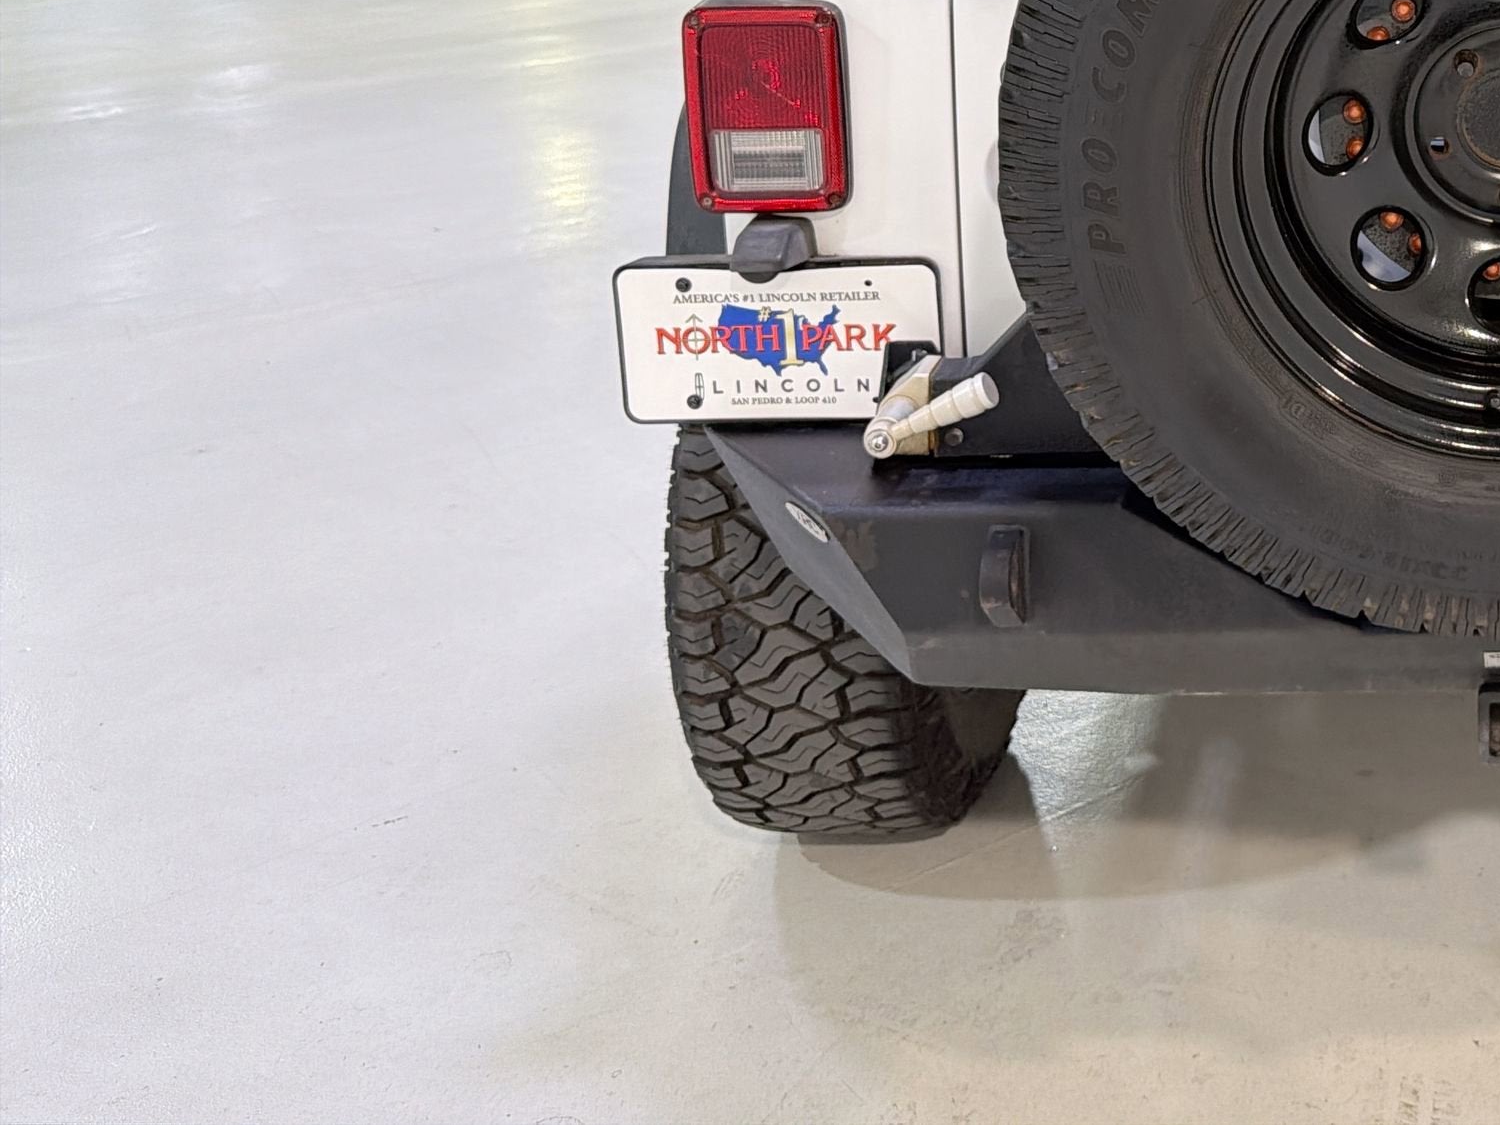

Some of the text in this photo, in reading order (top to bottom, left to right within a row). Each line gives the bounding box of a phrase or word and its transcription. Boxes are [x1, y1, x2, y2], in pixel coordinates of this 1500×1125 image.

[1081, 137, 1128, 256] PRO
[673, 290, 880, 305] AMERICA'S #1 LINCOLN RETAILER
[655, 322, 897, 355] NORTH PARK
[712, 377, 870, 395] LINCOLN
[731, 393, 837, 405] SAN PEDRO & LOOP 410
